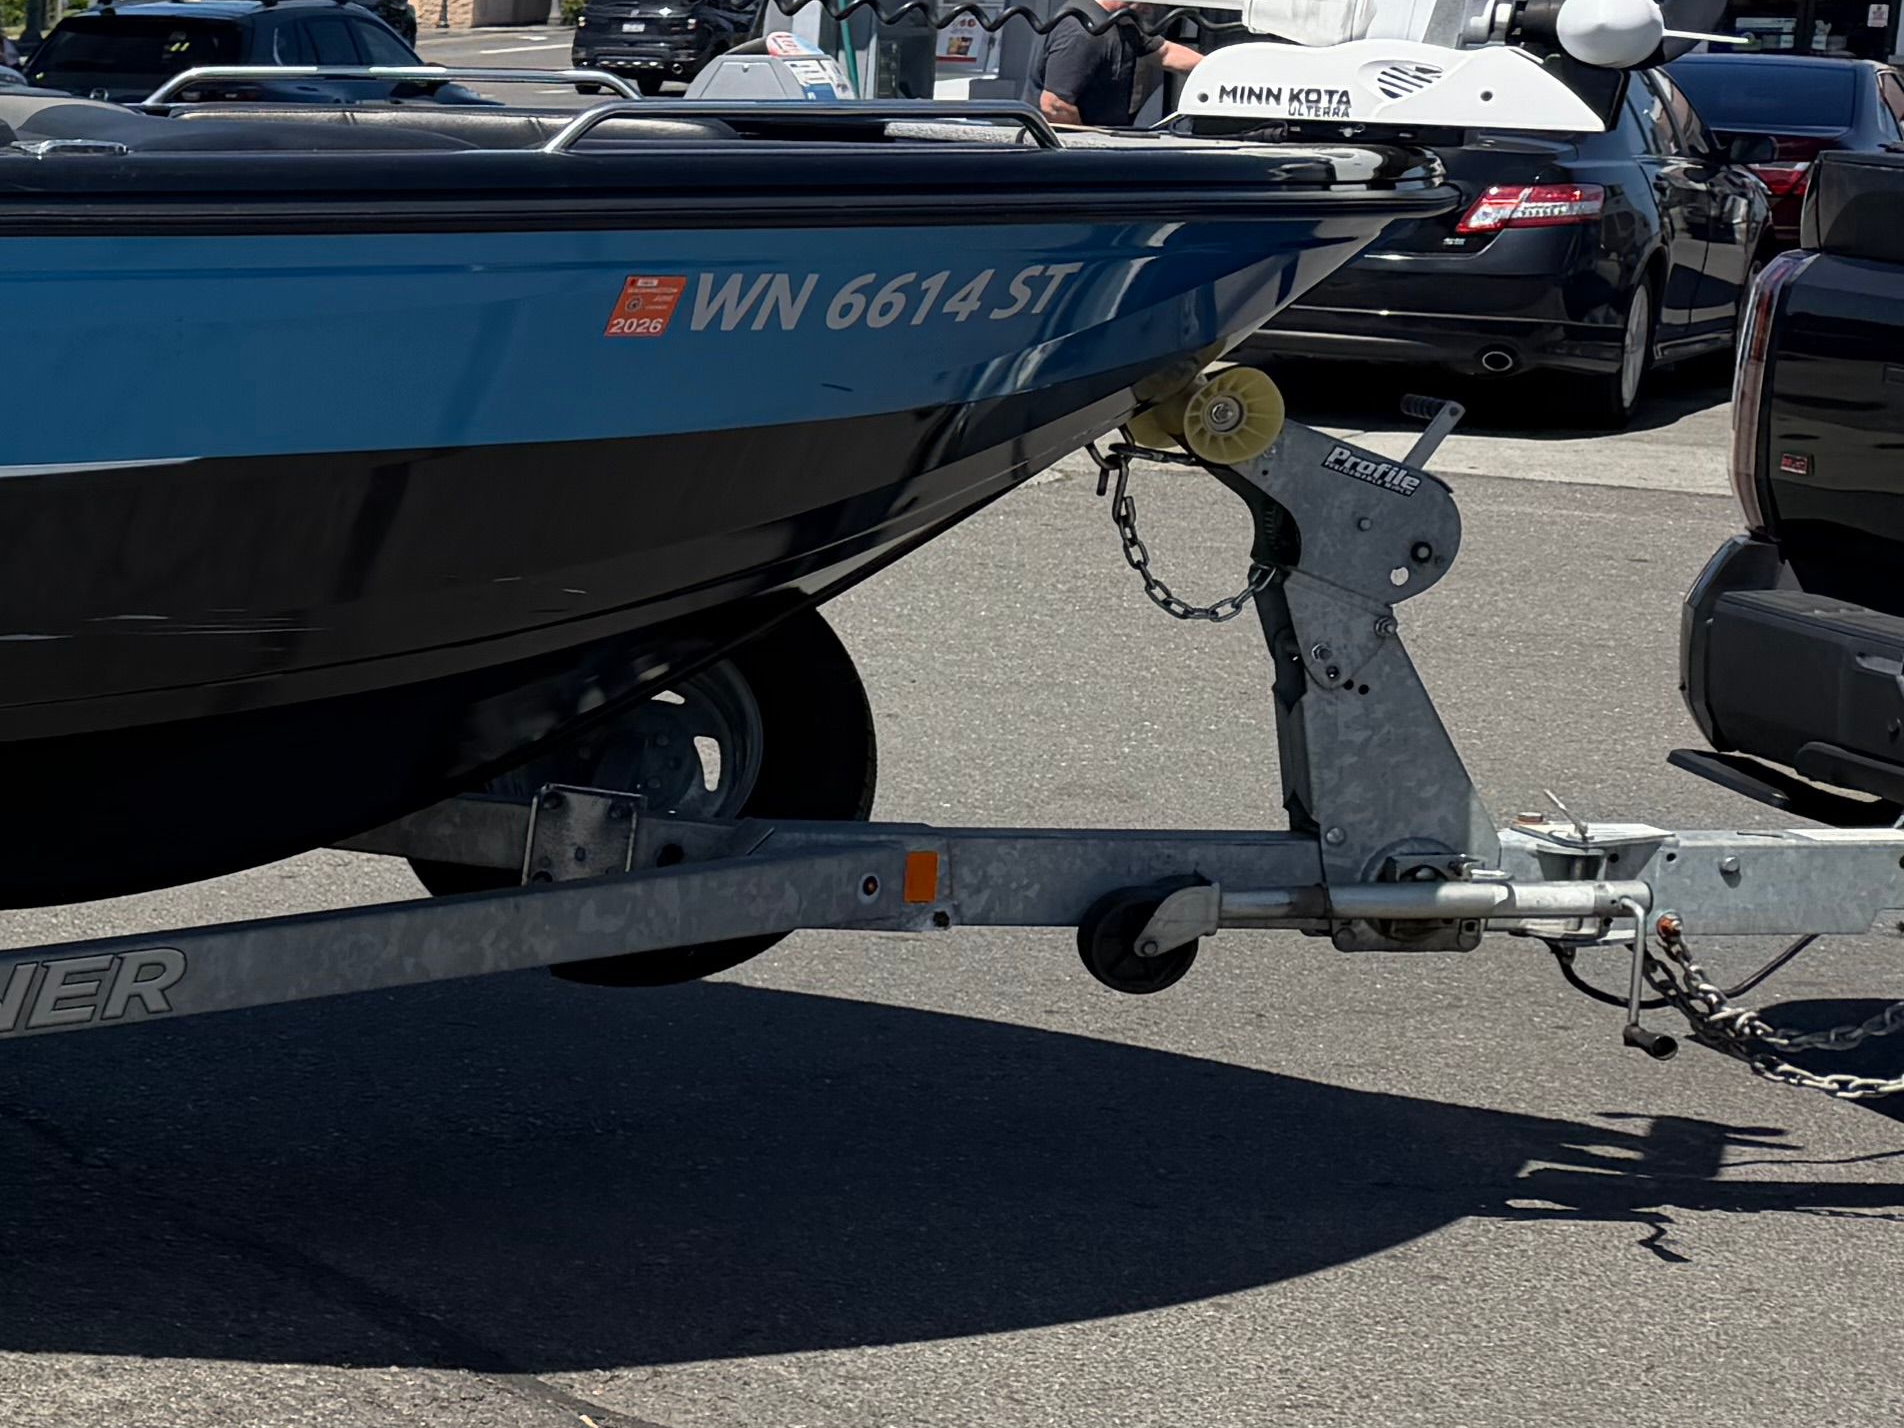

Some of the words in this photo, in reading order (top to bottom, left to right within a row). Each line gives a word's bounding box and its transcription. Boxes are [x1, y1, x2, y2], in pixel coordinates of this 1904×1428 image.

[1219, 85, 1282, 106] MINN
[1288, 88, 1352, 106] KOTA
[1288, 104, 1352, 118] ULTERRA
[690, 273, 819, 331] WN
[826, 270, 993, 330] 6614
[991, 262, 1084, 320] ST
[609, 318, 664, 333] 2026
[1326, 446, 1421, 491] Profile
